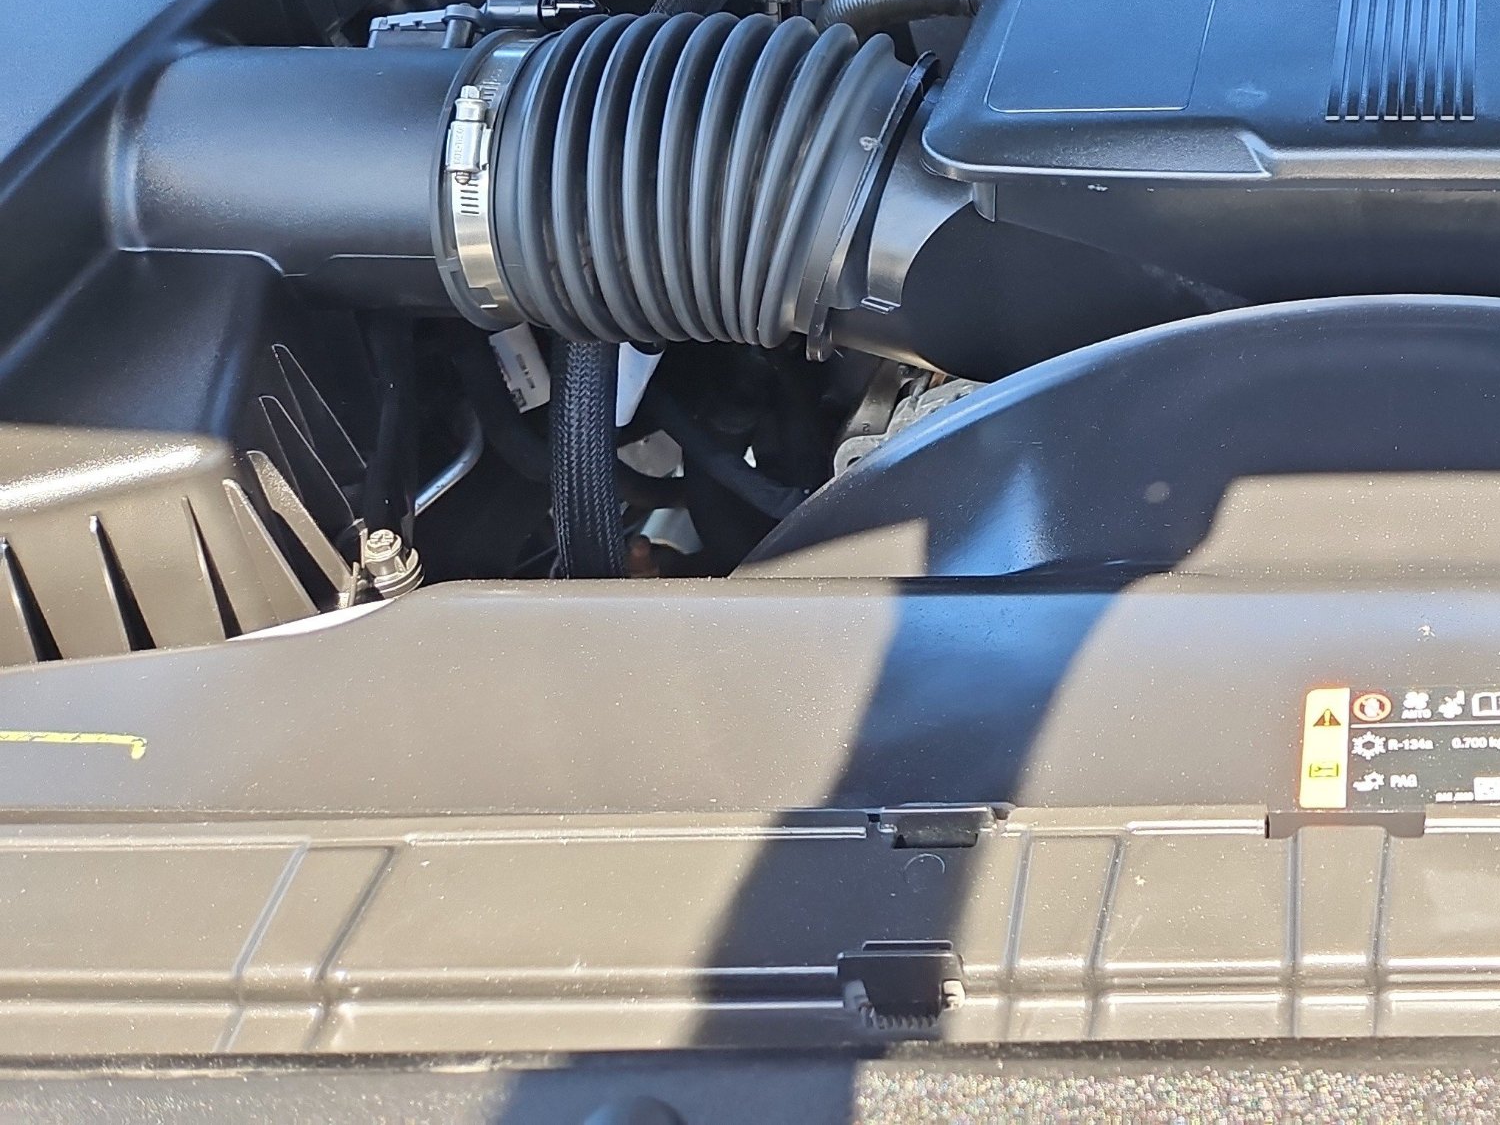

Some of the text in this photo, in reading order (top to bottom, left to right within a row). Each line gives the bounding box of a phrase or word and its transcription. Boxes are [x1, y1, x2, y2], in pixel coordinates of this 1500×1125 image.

[1388, 738, 1434, 751] R-134a
[1451, 737, 1488, 750] 0.700
[1390, 773, 1418, 789] PAG
